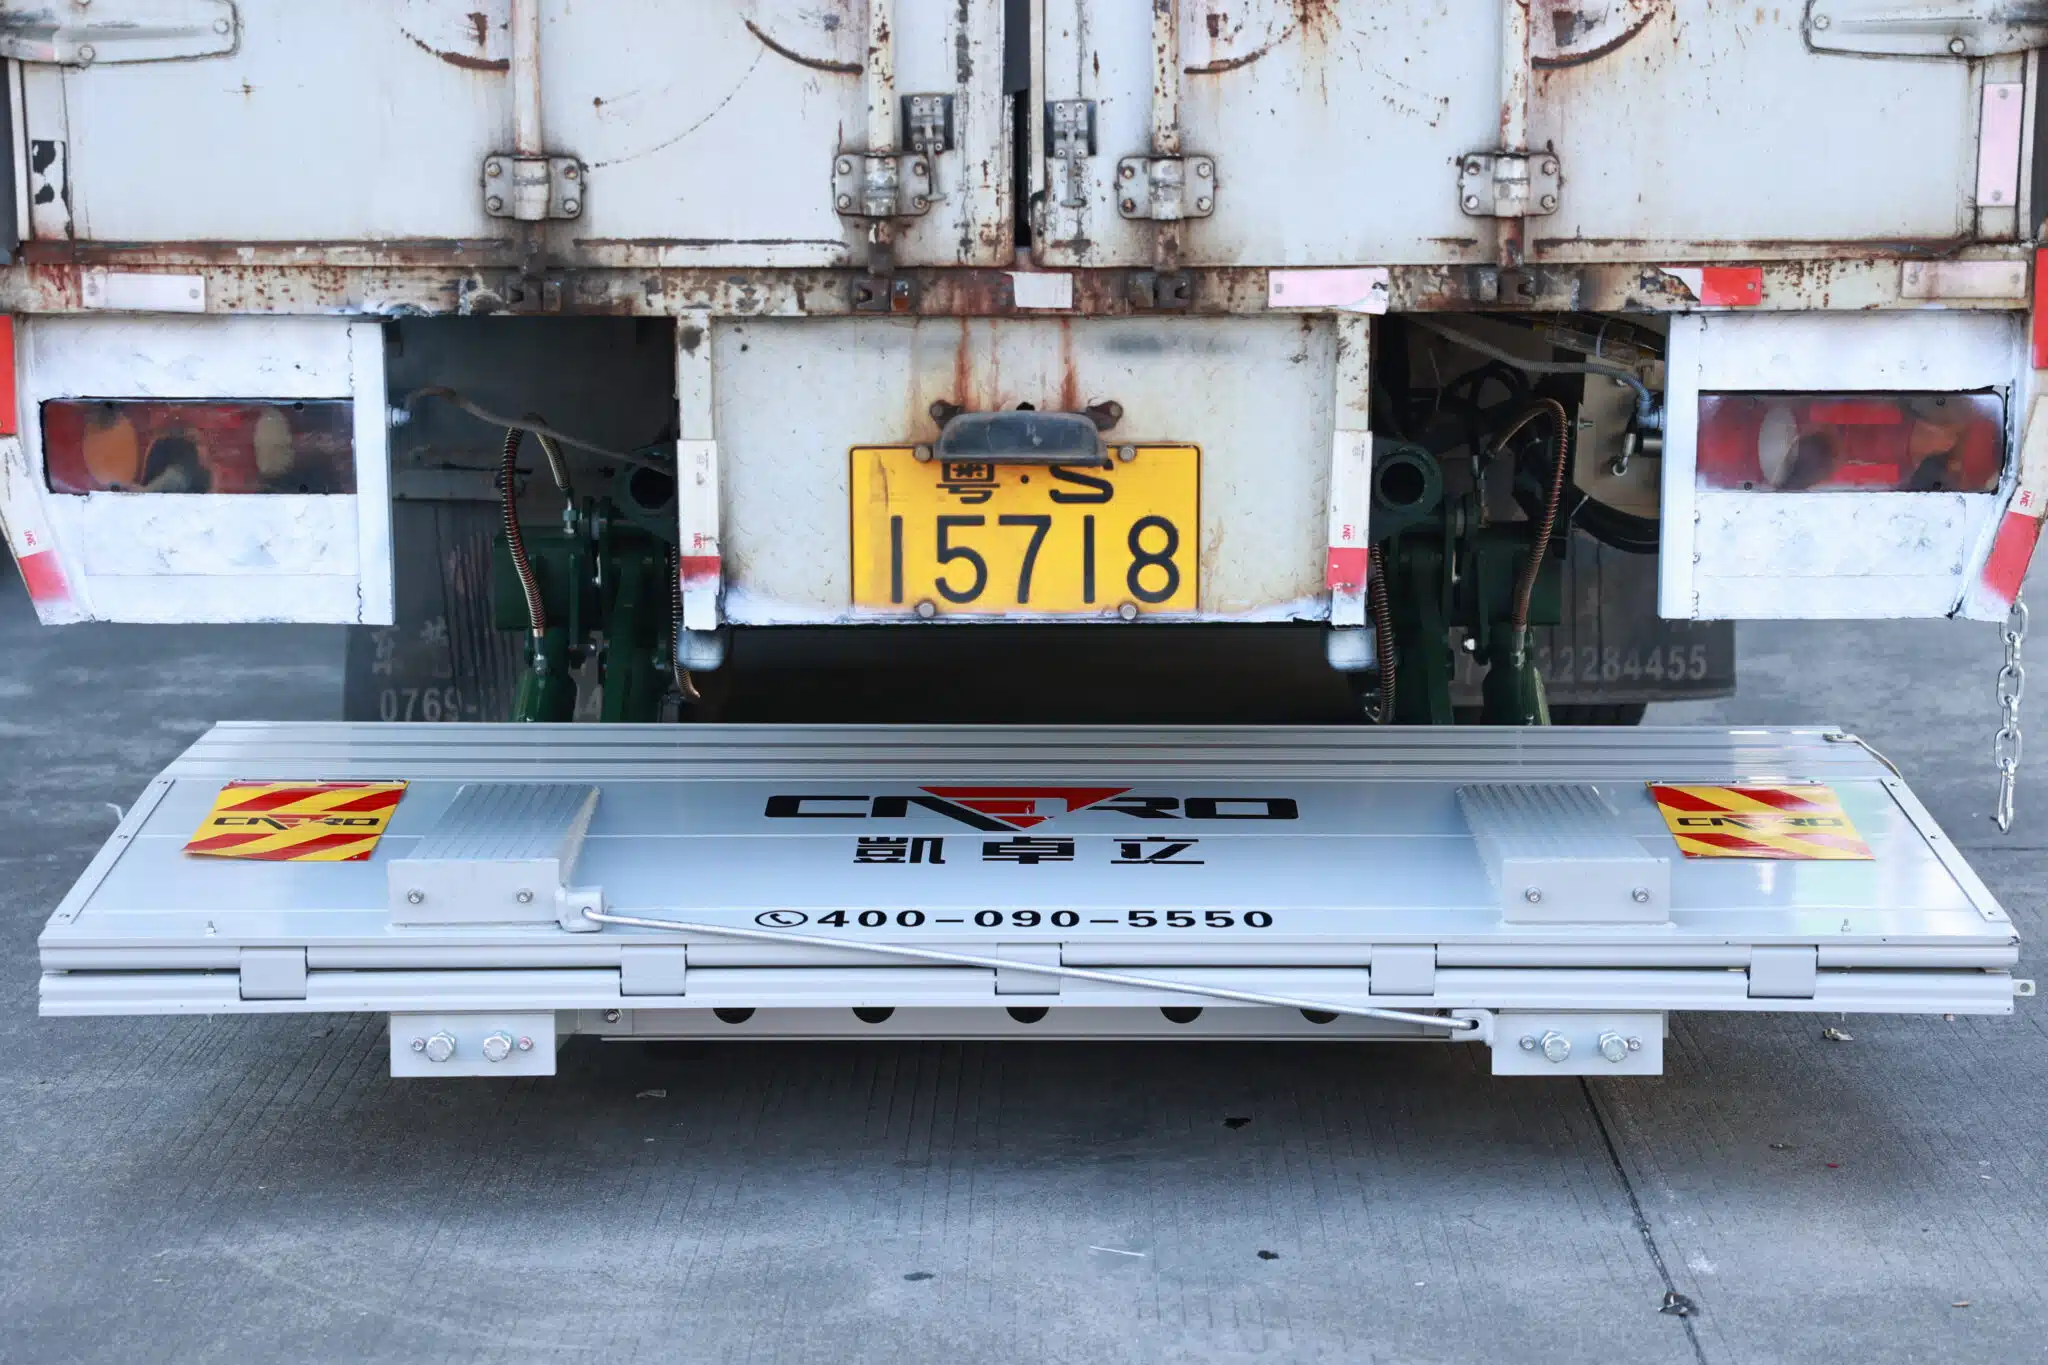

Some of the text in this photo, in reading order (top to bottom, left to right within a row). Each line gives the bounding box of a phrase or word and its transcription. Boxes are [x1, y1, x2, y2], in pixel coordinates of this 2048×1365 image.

[1342, 523, 1352, 541] 3M
[890, 514, 1181, 604] 15718
[816, 909, 1274, 929] 400-090-5550
